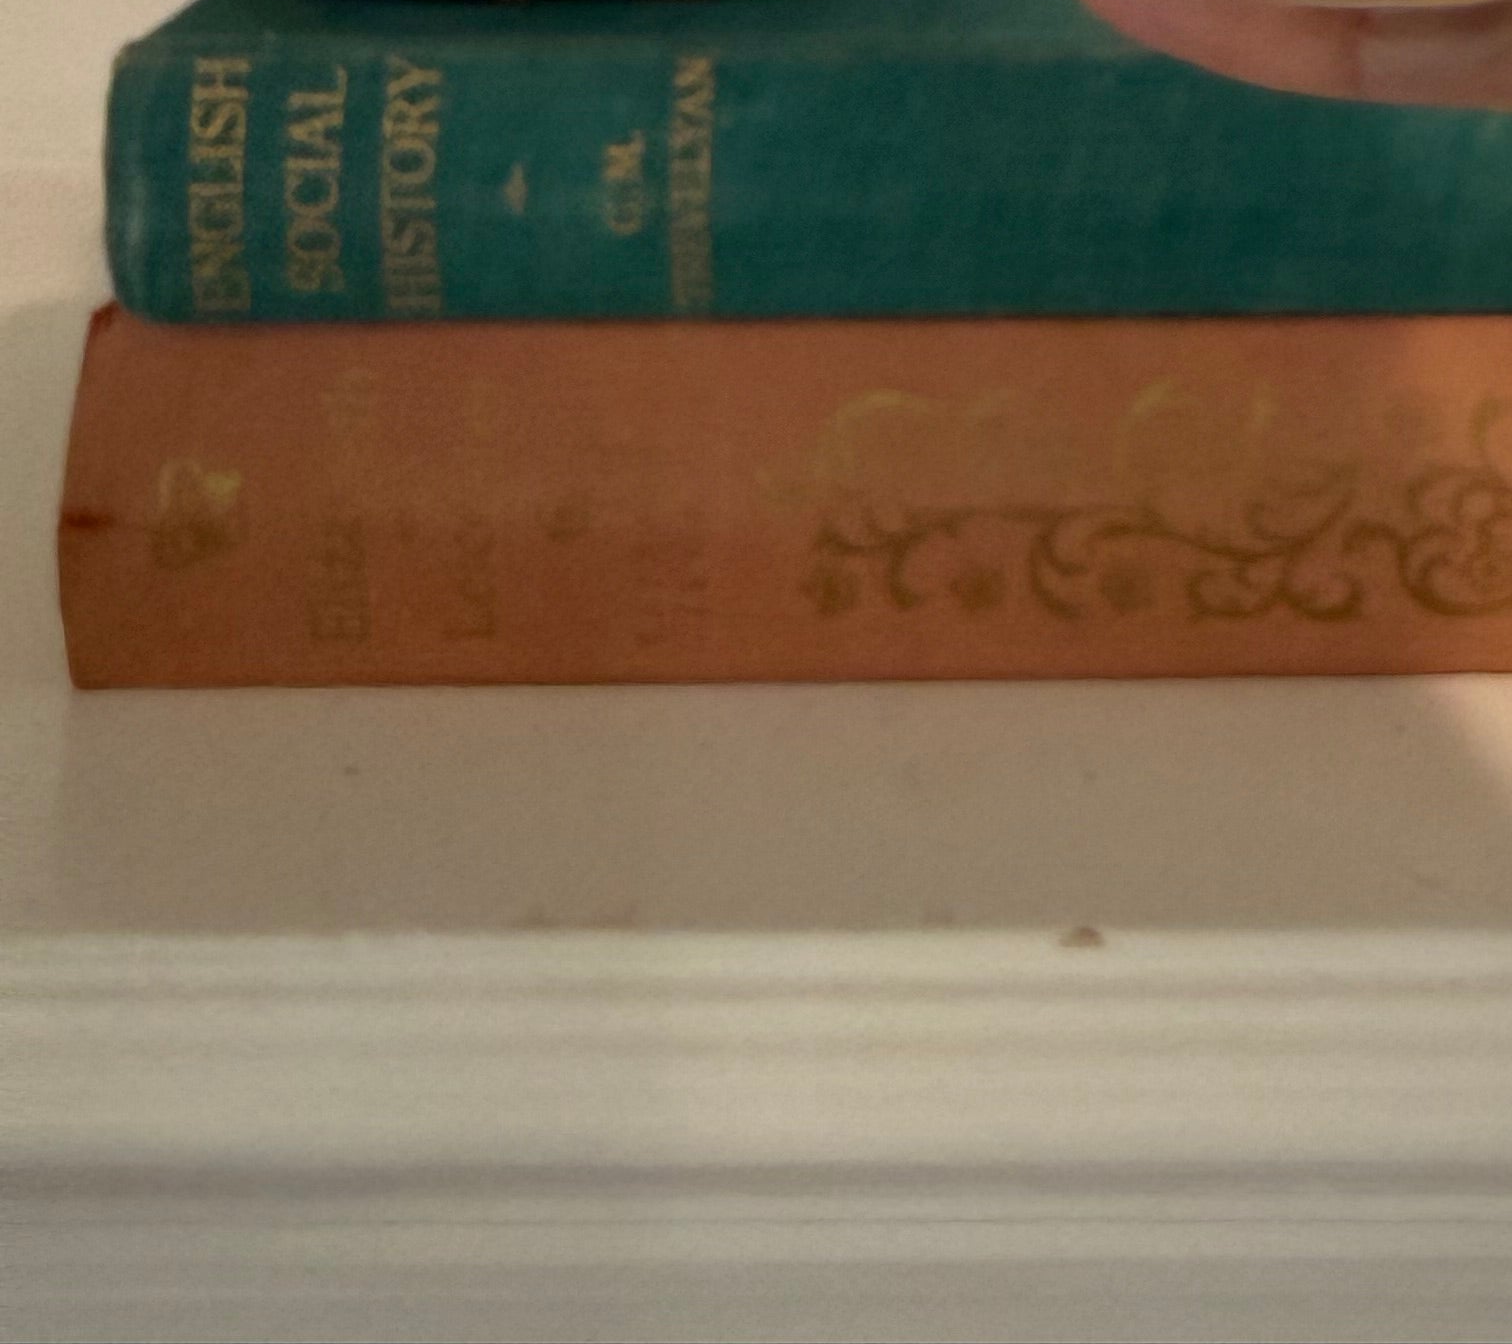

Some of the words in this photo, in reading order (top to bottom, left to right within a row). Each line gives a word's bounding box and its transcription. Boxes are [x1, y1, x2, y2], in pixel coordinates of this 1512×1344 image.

[188, 57, 252, 312] ENGLISH
[285, 64, 348, 294] SOCIAL
[380, 54, 444, 312] HISTORY
